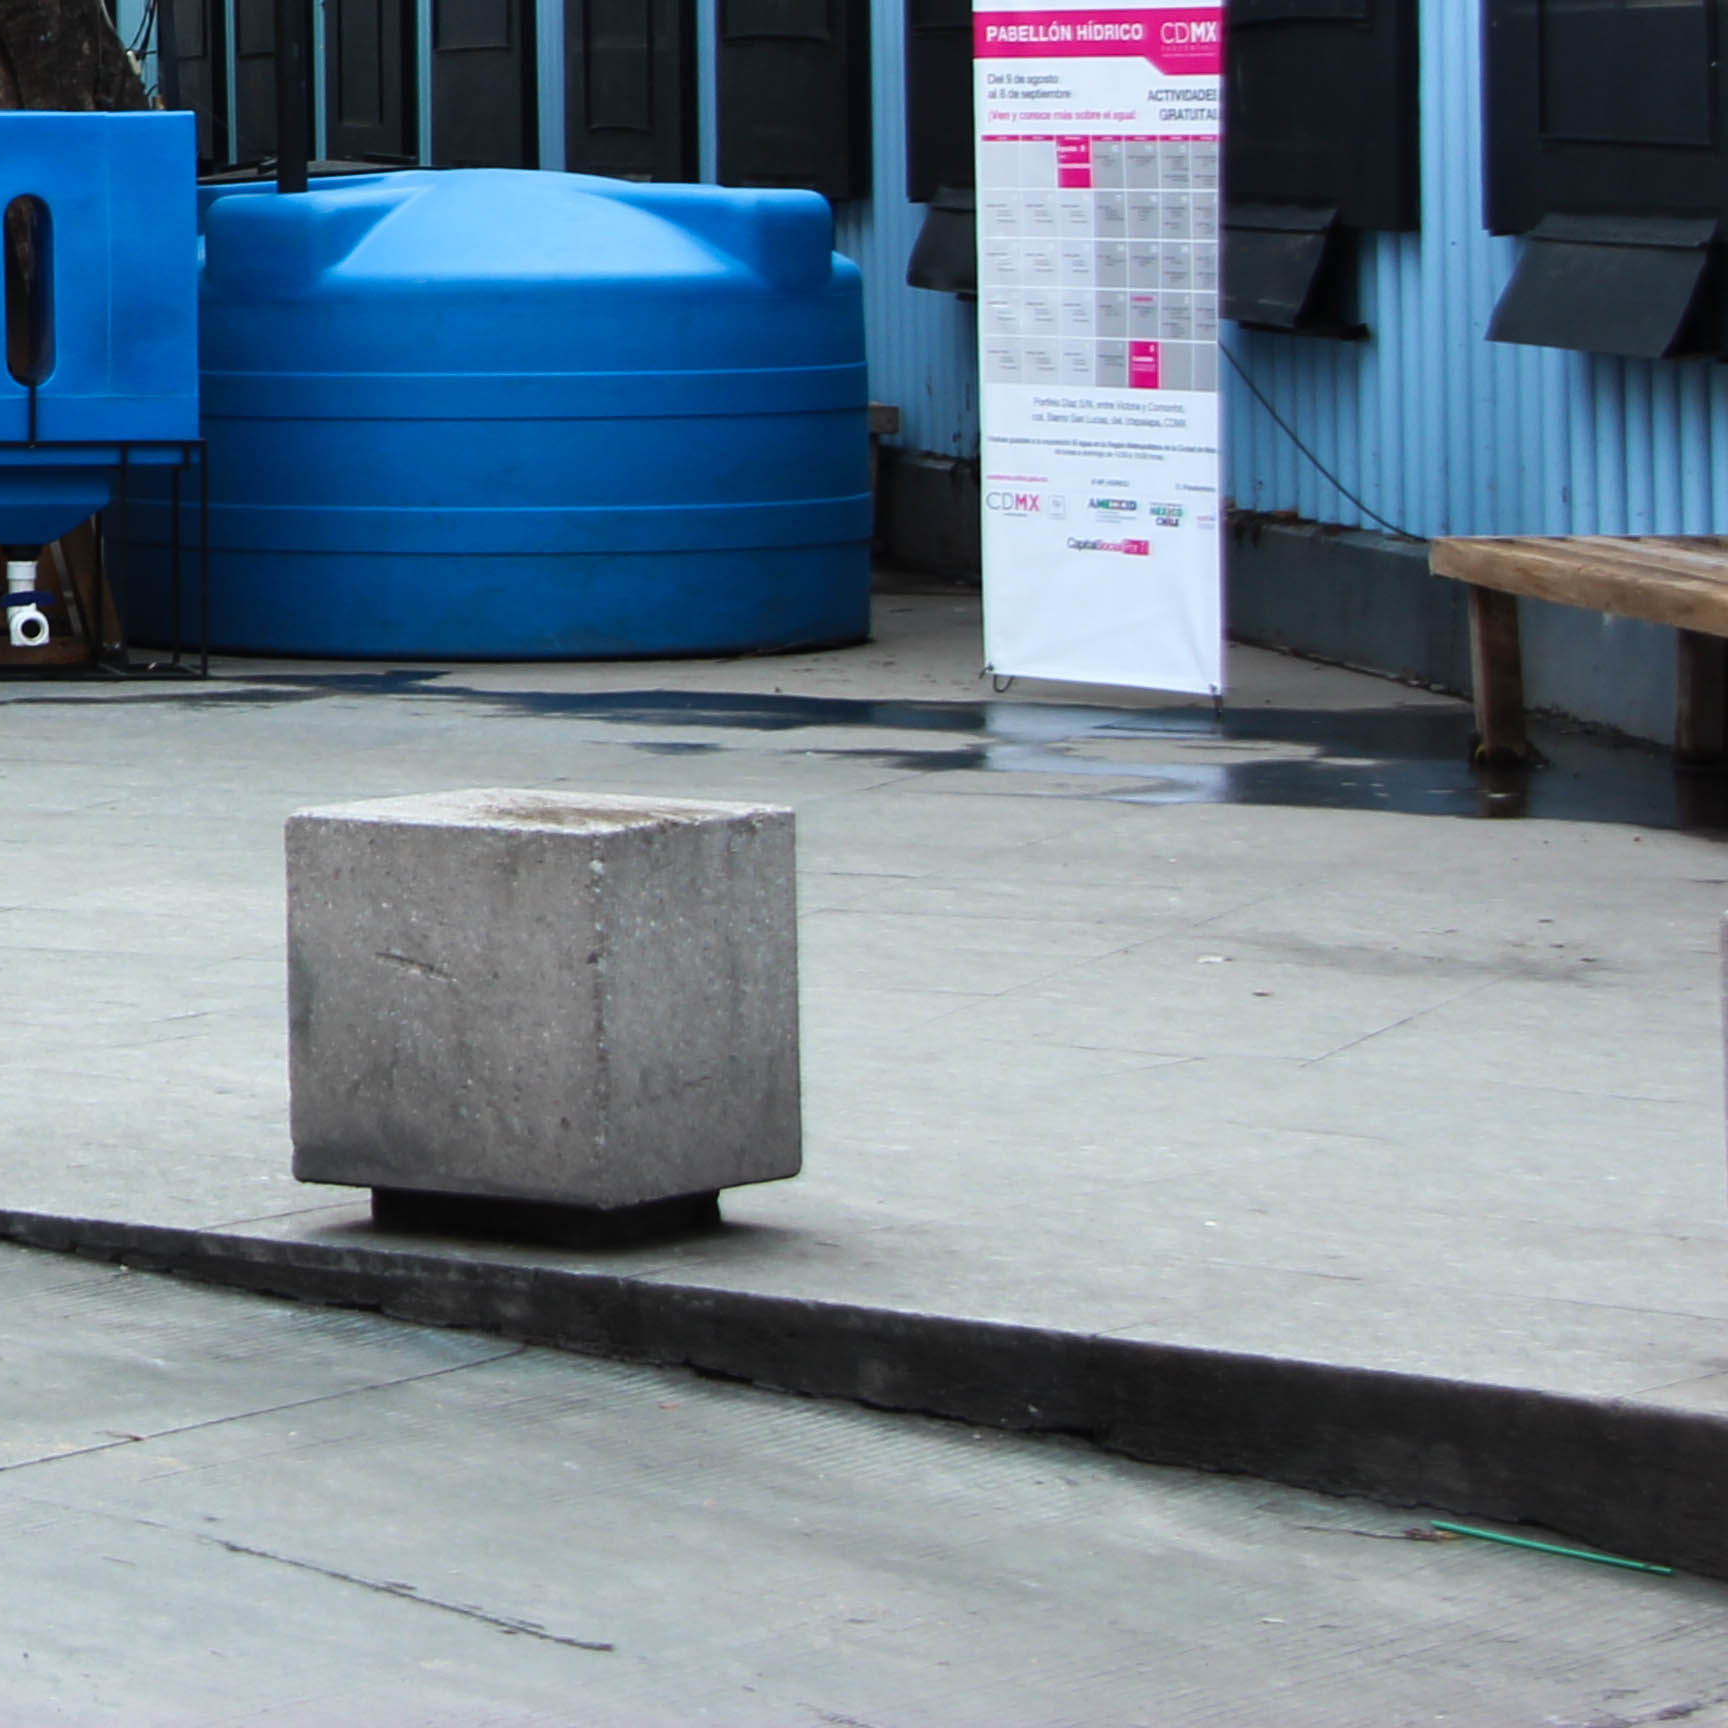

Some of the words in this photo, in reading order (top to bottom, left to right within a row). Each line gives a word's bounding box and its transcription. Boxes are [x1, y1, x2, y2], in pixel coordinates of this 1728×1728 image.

[986, 21, 1072, 42] PABELLÓN
[1076, 20, 1144, 41] HÍDRICO
[1160, 22, 1217, 44] CDMX
[985, 491, 1040, 512] CDMX
